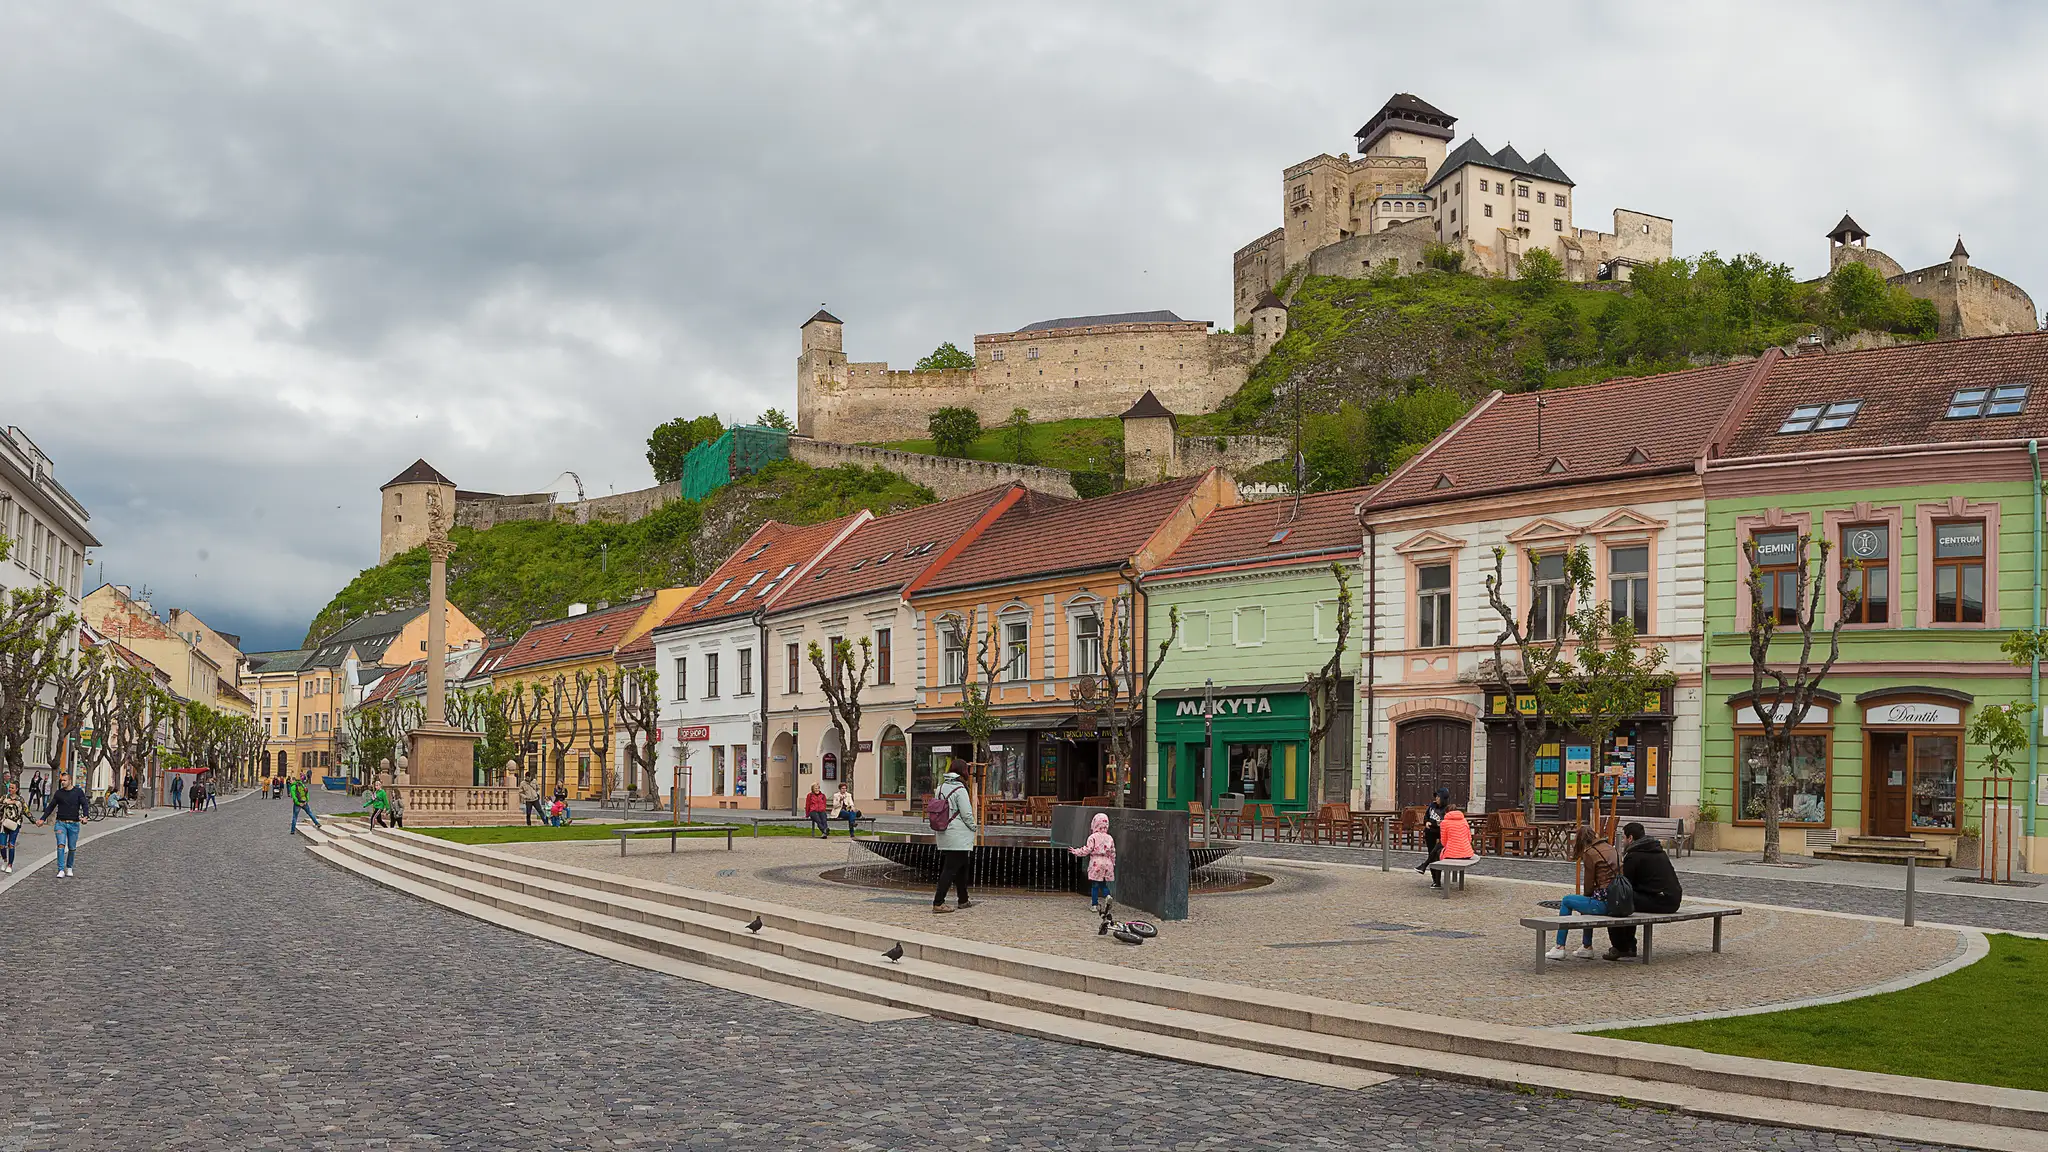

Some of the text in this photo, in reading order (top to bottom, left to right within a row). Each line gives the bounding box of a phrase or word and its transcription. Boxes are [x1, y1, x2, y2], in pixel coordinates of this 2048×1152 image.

[1940, 535, 1980, 545] CENTRUM
[1758, 543, 1794, 554] GEMINI
[1519, 699, 1539, 711] LAS
[1888, 704, 1939, 723] Dantik
